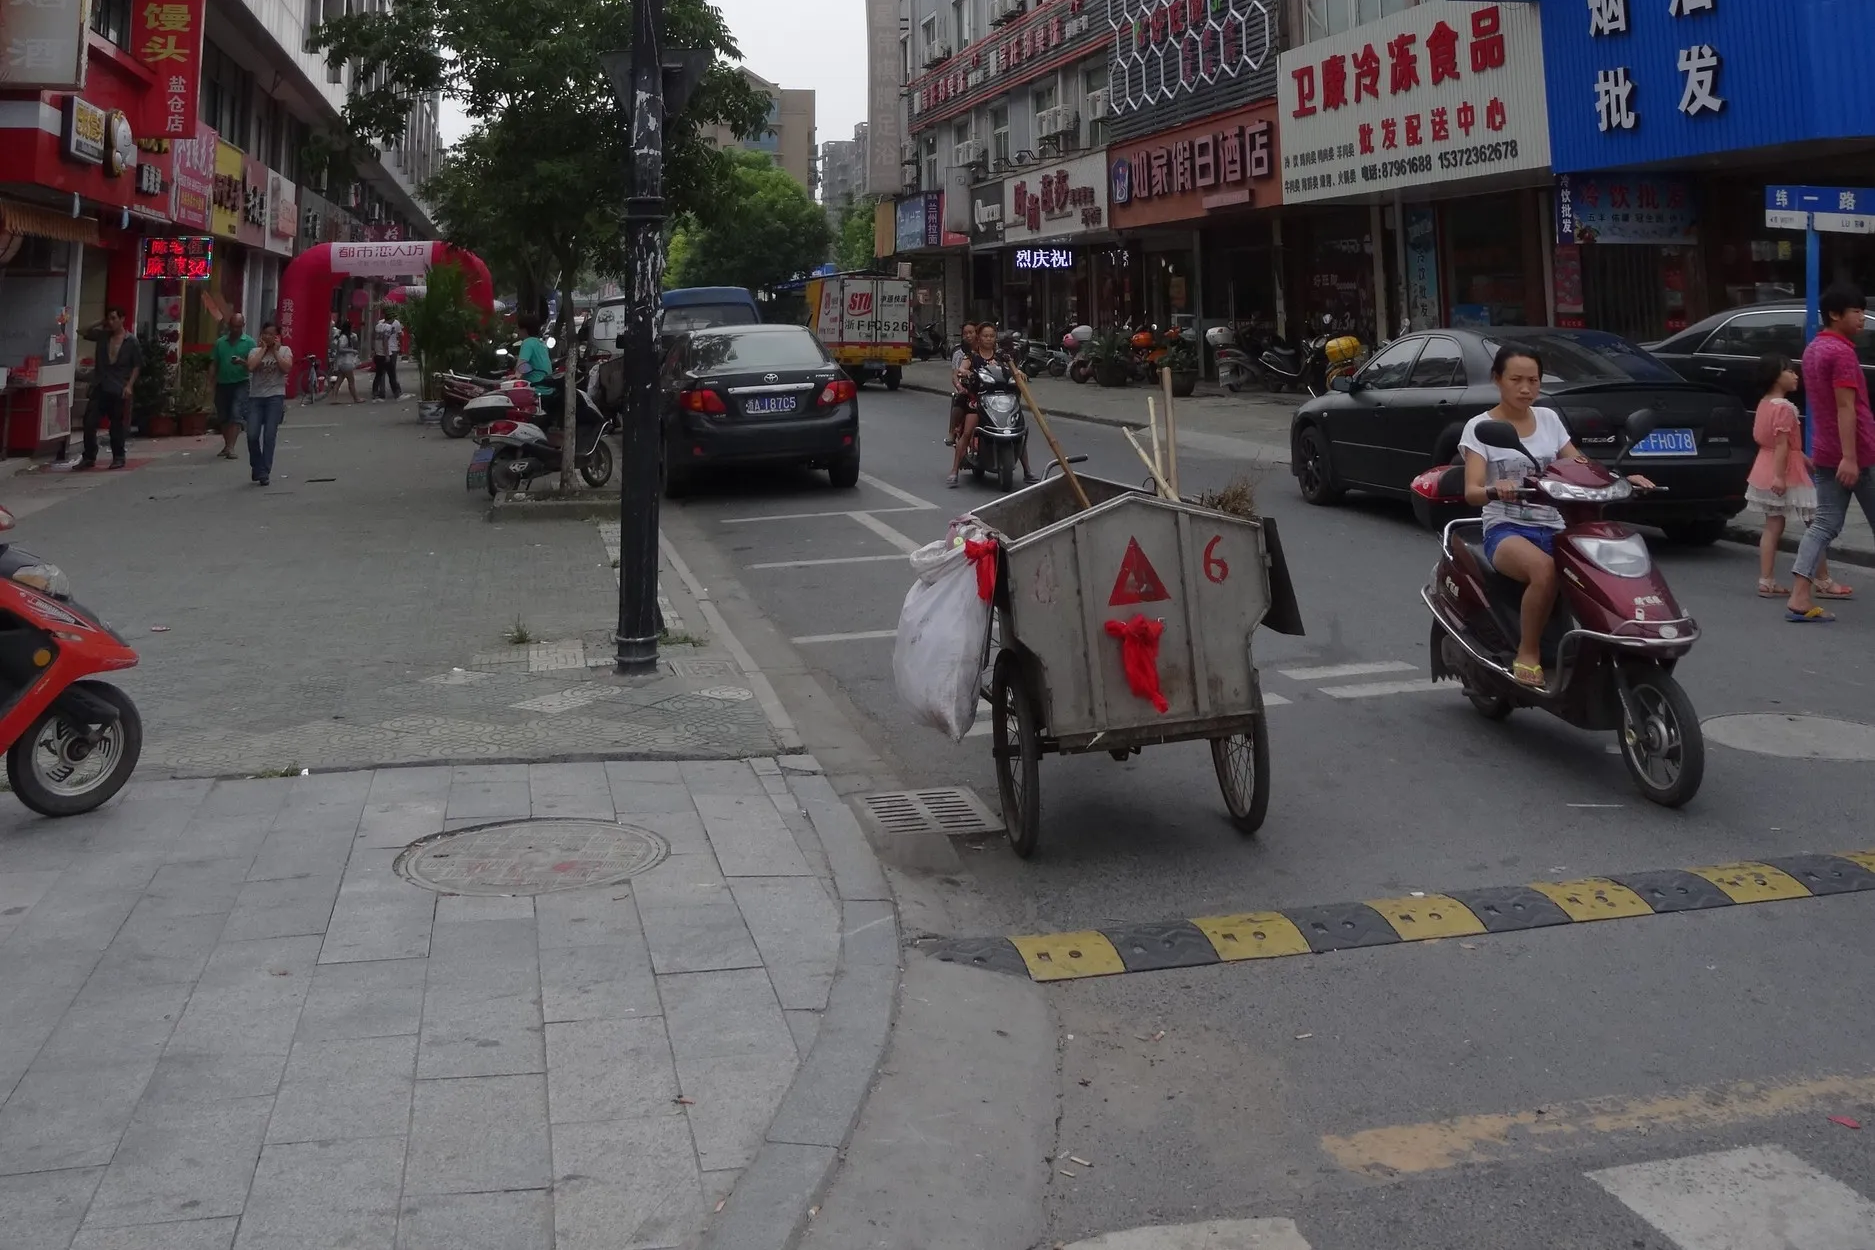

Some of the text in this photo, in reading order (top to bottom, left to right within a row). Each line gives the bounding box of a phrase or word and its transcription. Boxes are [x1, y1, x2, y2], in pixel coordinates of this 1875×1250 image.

[1292, 5, 1506, 119] 卫康冷冻食品
[1594, 45, 1726, 134] 批发
[165, 74, 187, 133] 盐仓店
[1358, 97, 1507, 155] 批发配送中心
[1132, 119, 1272, 198] 如家假日酒店
[1437, 138, 1519, 170] 15372362678
[927, 202, 938, 246] 兰州拉面
[1560, 174, 1573, 234] 冷饮批发
[1775, 188, 1856, 211] 纬一路
[338, 244, 425, 259] 都市恋人坊
[1203, 534, 1229, 584] 6
